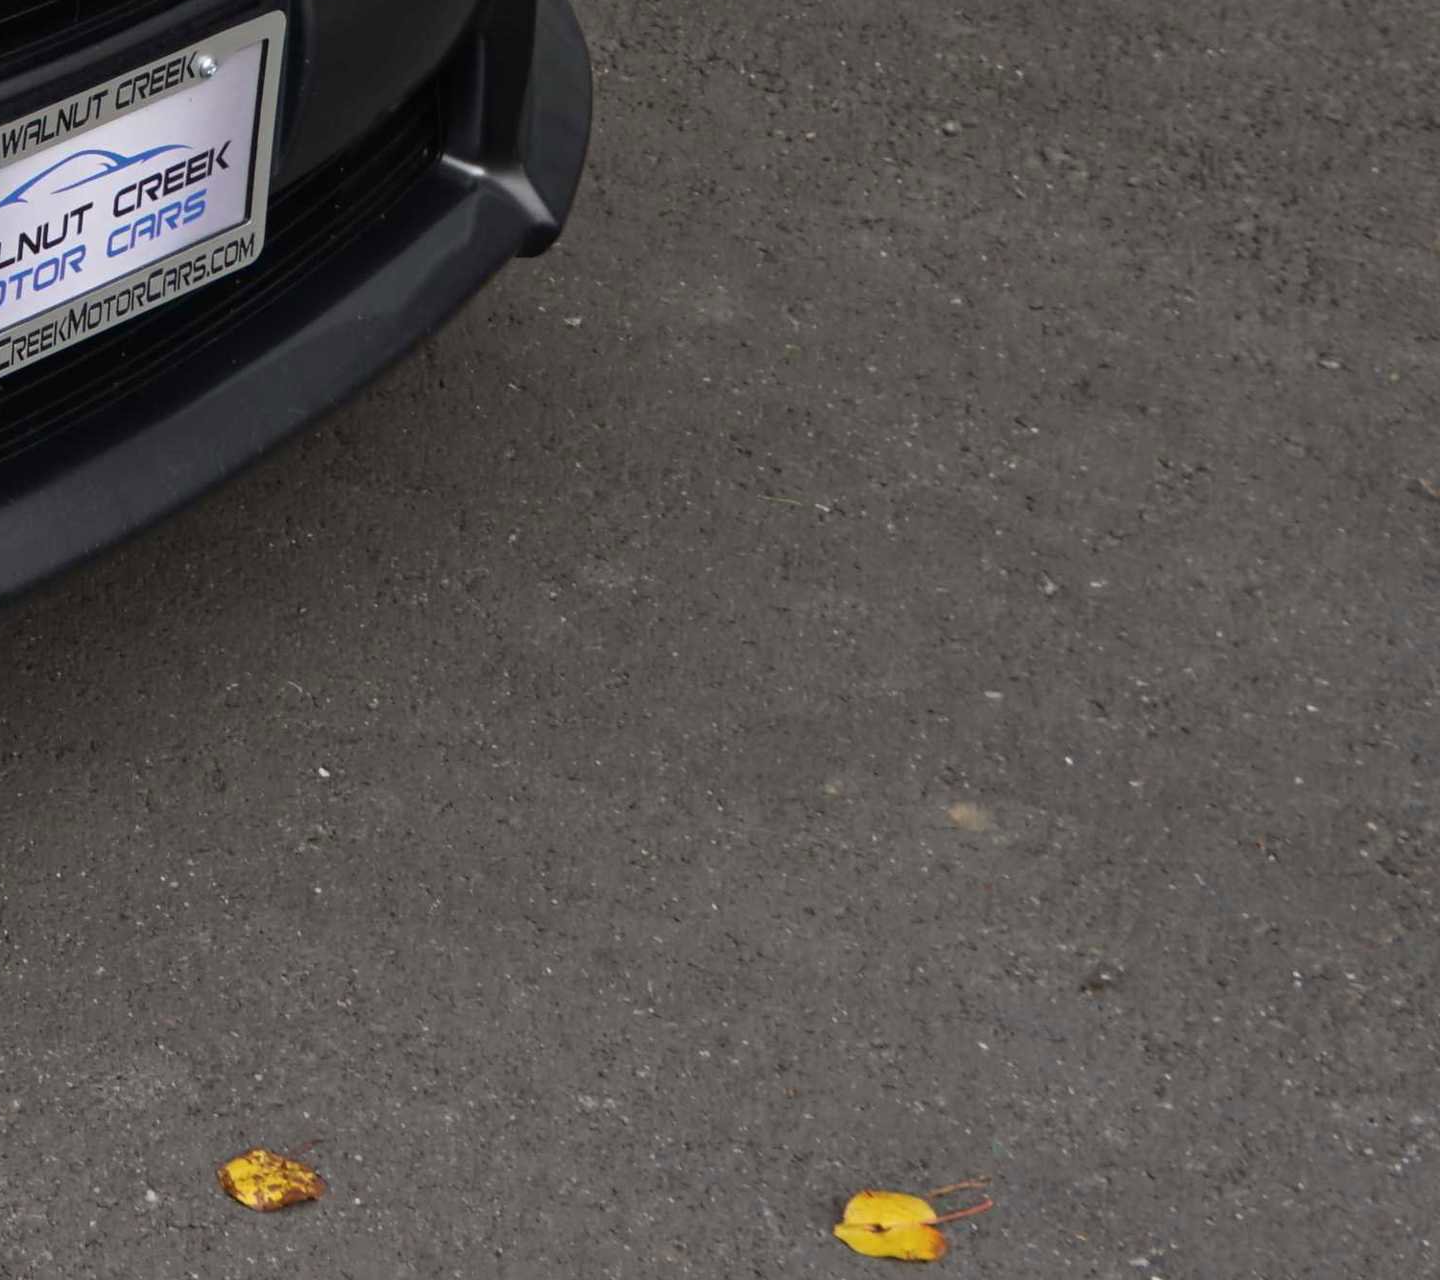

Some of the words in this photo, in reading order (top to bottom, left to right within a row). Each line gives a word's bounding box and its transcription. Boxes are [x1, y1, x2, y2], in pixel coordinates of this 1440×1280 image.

[1, 91, 109, 159] WALNUT
[115, 51, 198, 110] CREEK
[112, 140, 233, 218] CREEK
[106, 189, 209, 259] CARS
